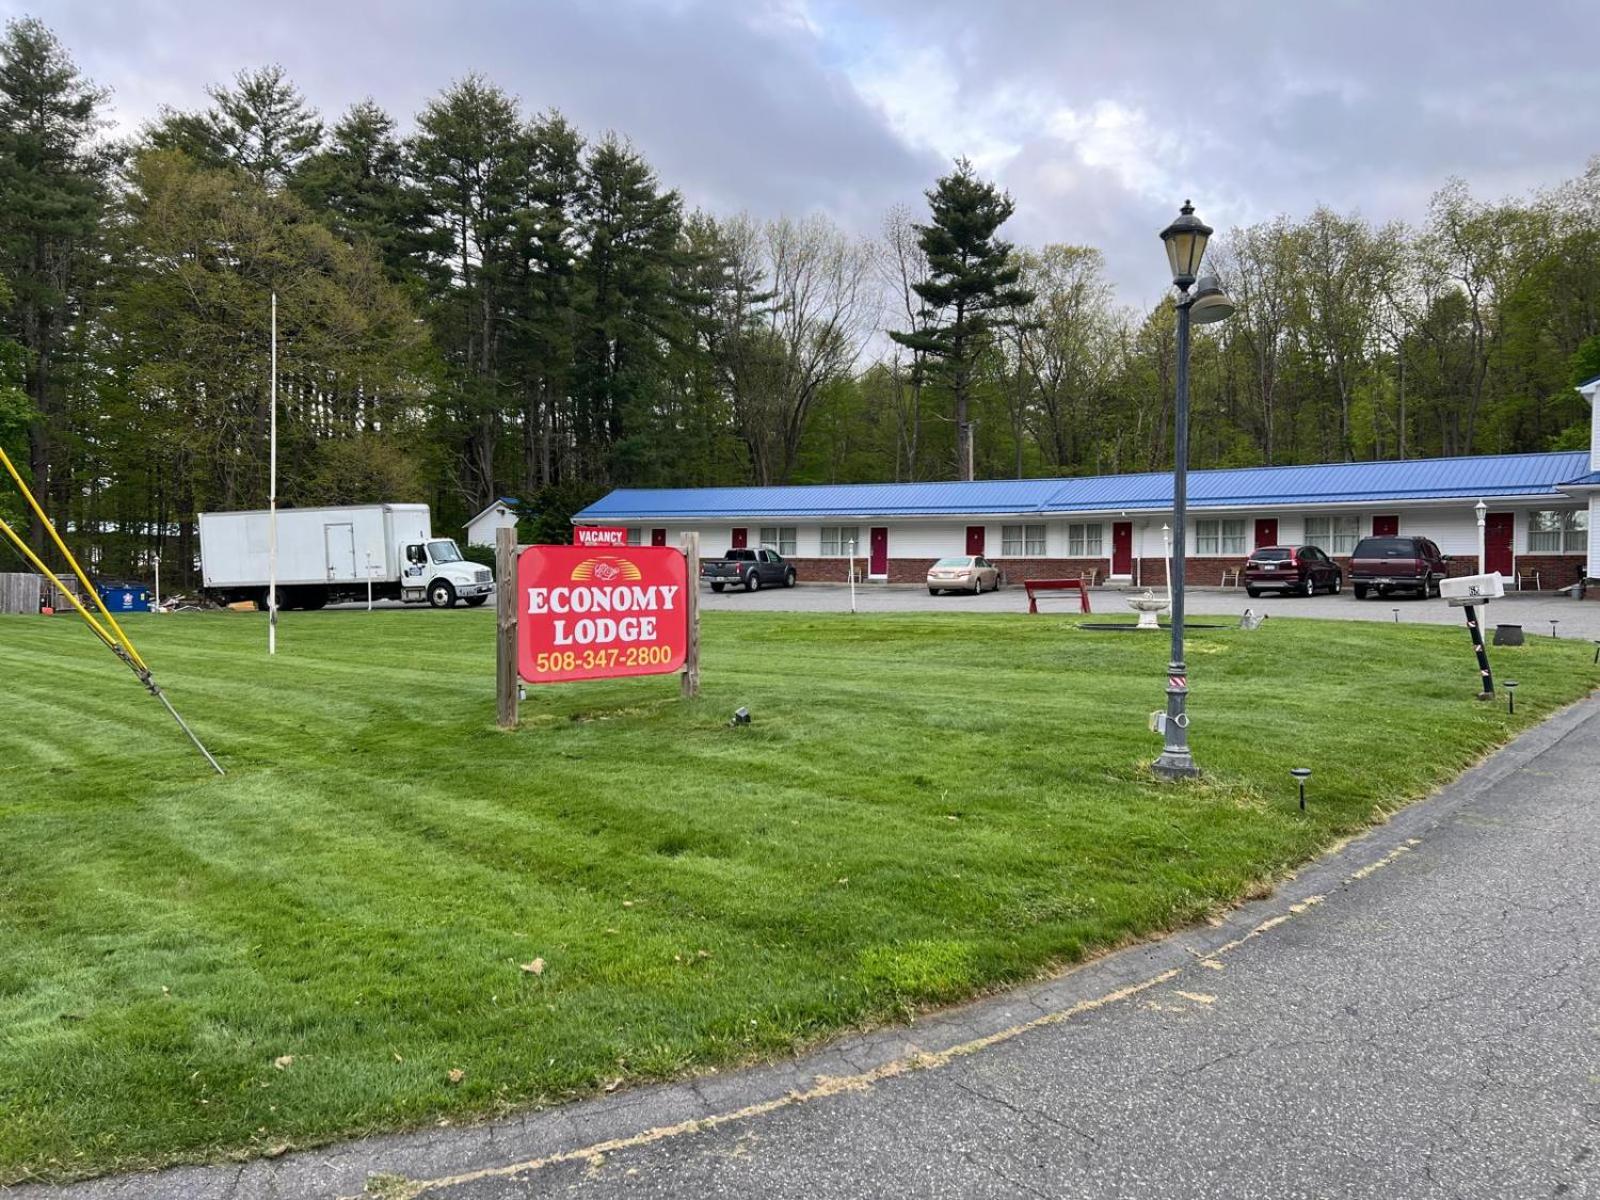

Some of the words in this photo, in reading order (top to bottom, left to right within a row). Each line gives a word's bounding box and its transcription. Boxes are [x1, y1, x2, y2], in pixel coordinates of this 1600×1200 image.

[578, 530, 623, 543] VACANCY
[527, 585, 679, 614] ECONOMY
[553, 616, 657, 645] LODGE
[536, 646, 672, 672] 508-347-2800
